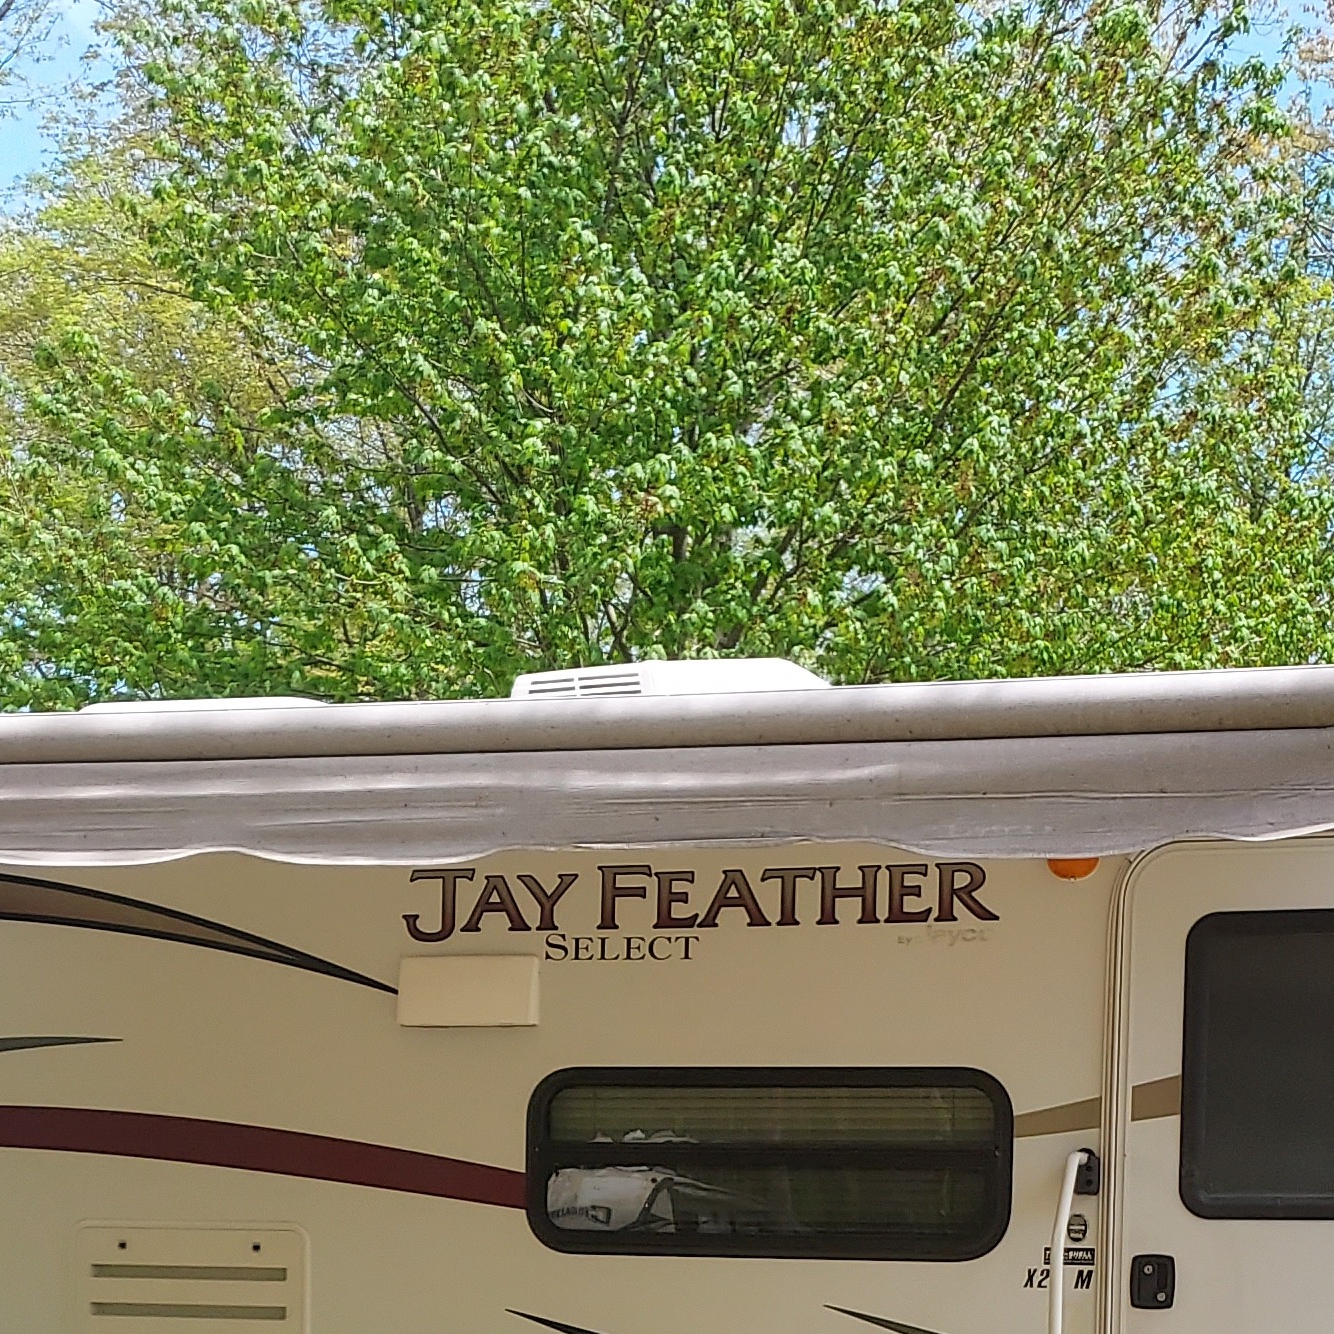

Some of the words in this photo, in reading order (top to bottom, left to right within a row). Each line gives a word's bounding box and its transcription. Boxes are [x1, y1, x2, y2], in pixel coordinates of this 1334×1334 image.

[402, 867, 578, 942] JAY
[597, 861, 1000, 930] FEATHER
[544, 932, 699, 961] SELECT
